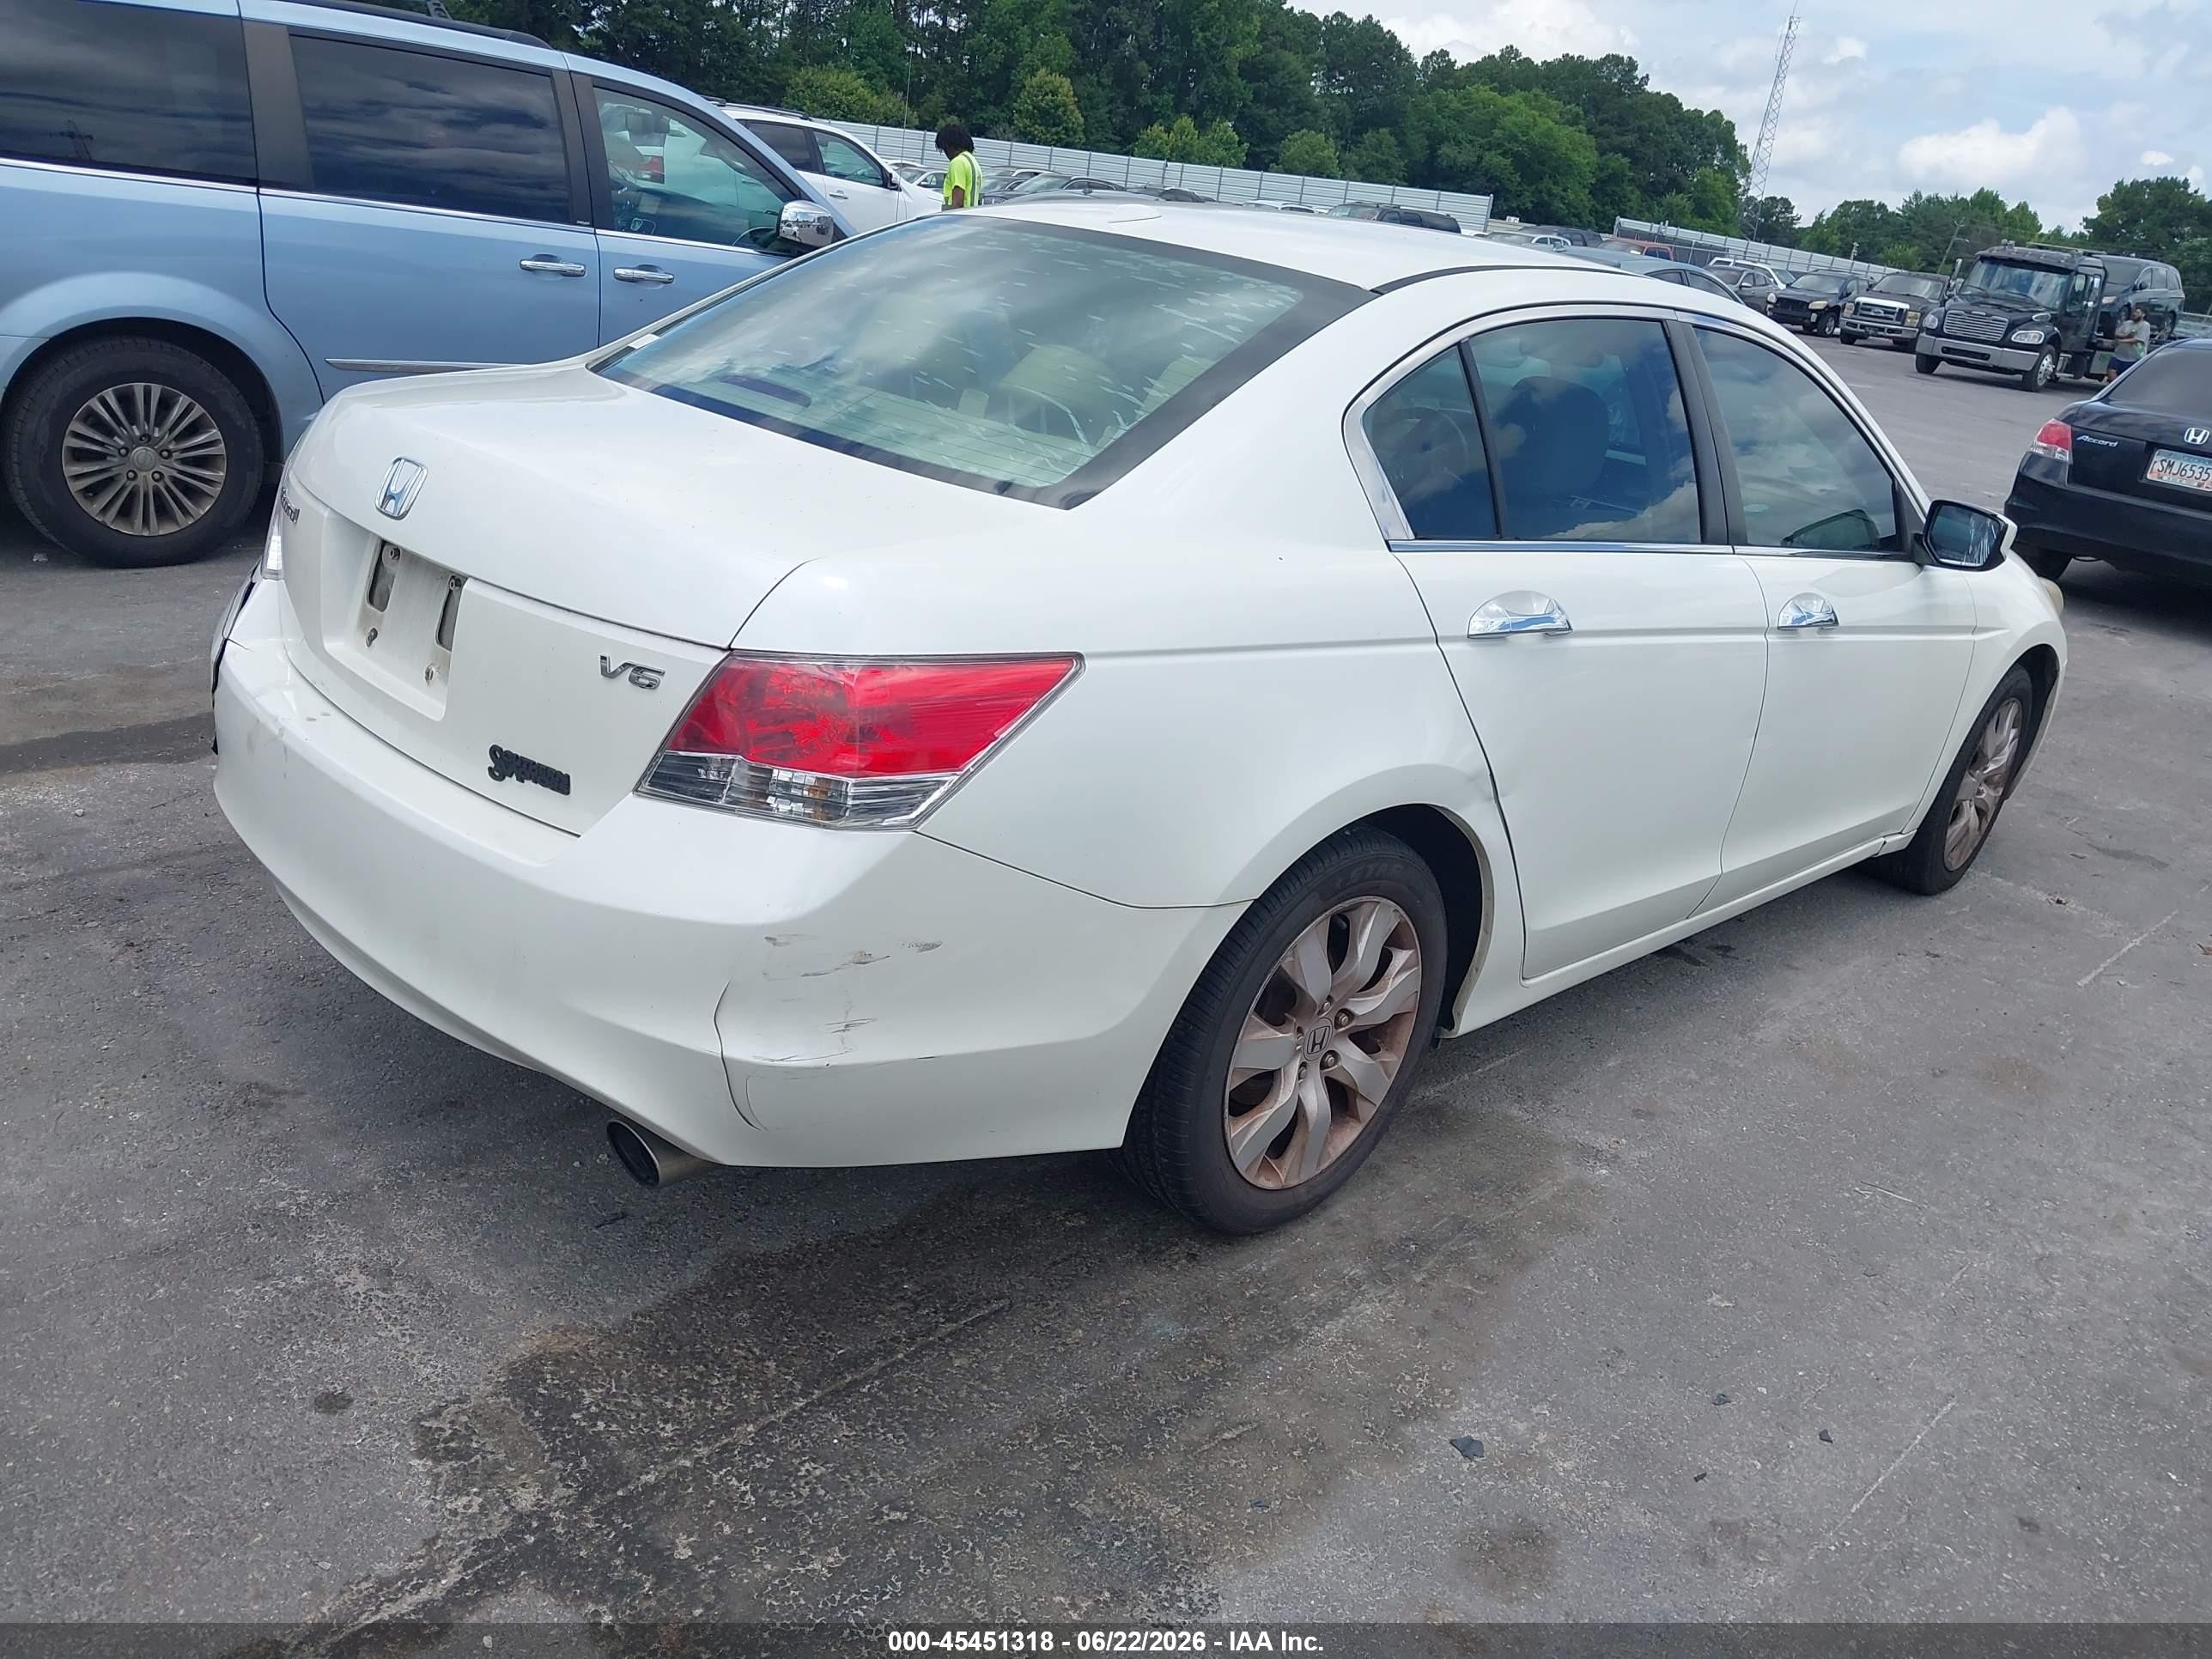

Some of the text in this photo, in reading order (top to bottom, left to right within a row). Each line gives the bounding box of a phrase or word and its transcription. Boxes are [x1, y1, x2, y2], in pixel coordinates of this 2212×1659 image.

[2076, 434, 2119, 447] Accord
[2156, 459, 2212, 482] SMJ6535
[600, 654, 665, 690] V6
